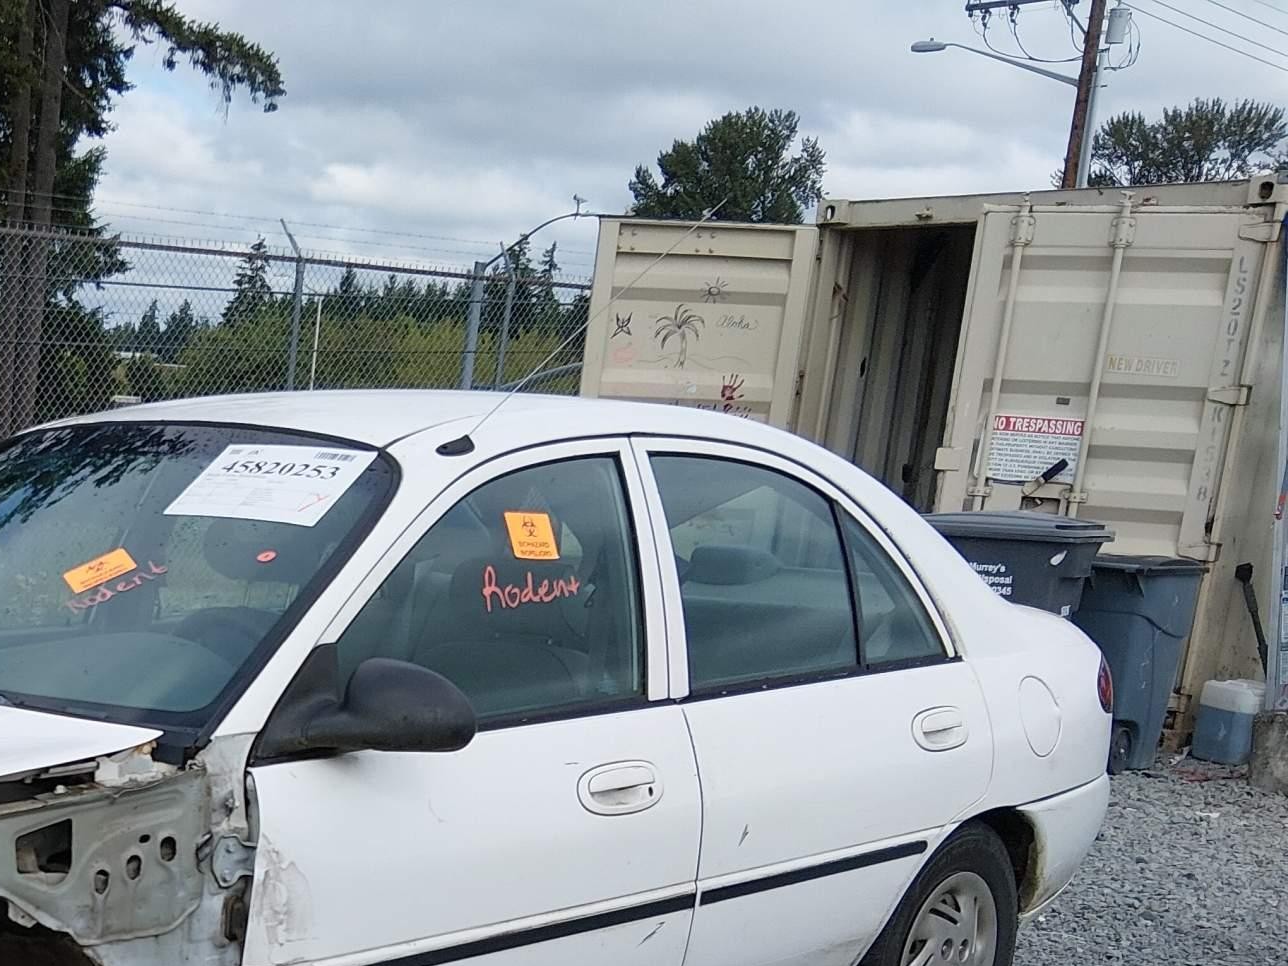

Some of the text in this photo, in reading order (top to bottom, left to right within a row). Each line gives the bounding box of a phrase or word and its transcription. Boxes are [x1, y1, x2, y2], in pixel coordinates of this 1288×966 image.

[1107, 356, 1178, 376] NEW DRIVER
[1009, 417, 1082, 435] TRESPASSING
[221, 460, 341, 480] 45820253
[481, 565, 580, 613] Rodent
[978, 574, 1013, 585] isposal
